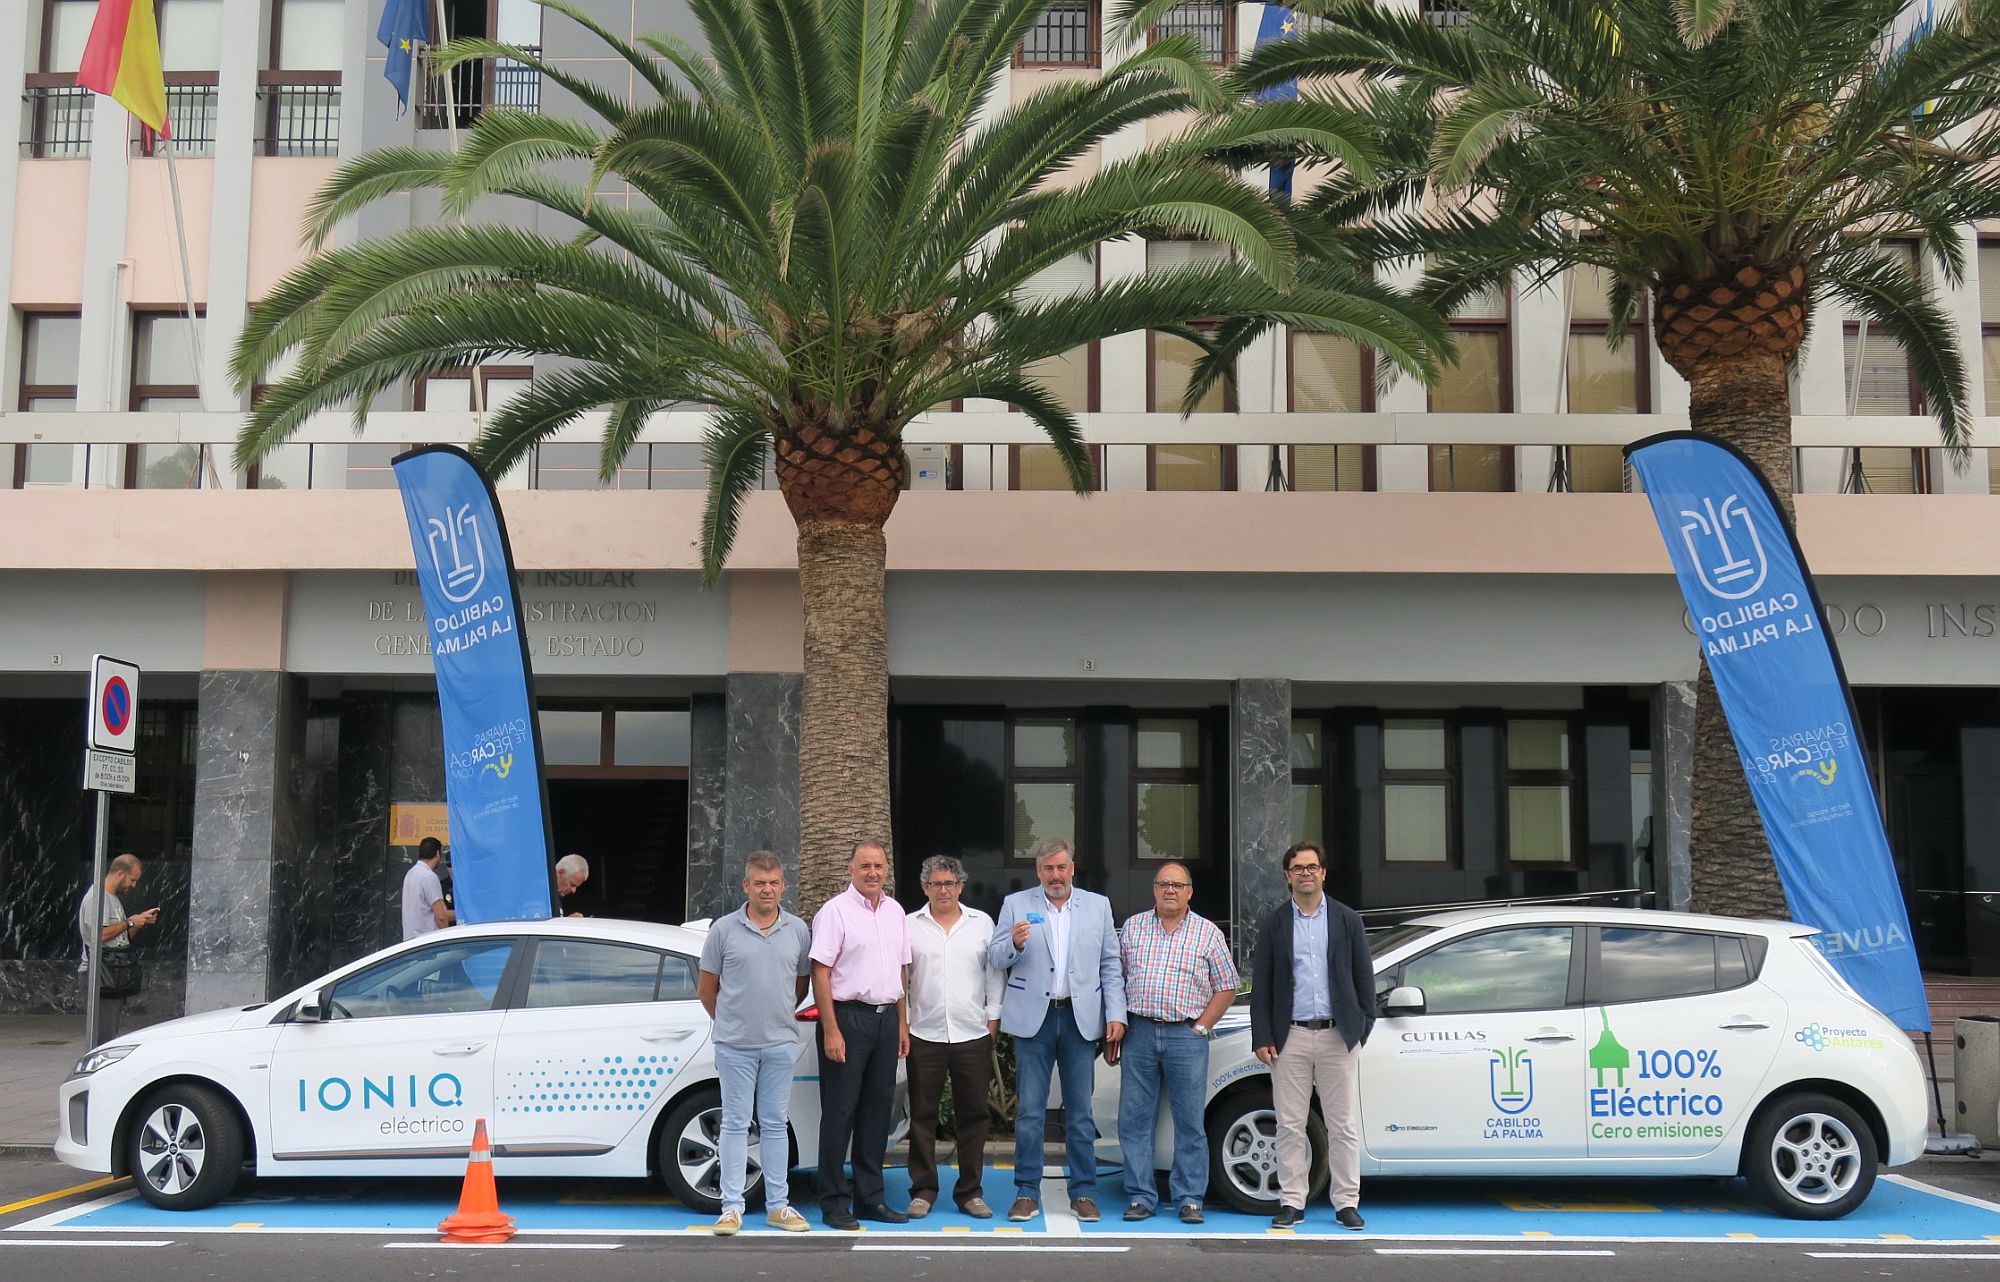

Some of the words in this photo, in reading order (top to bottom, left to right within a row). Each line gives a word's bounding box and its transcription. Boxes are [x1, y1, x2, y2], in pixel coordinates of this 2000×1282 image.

[537, 571, 636, 588] INSULAR
[368, 601, 394, 622] DE
[1926, 603, 1997, 638] INS
[546, 635, 644, 657] ESTADO
[1401, 1030, 1487, 1043] CUTILLAS
[1822, 1027, 1867, 1038] Proyecto
[1833, 1037, 1884, 1049] Antares
[1637, 1049, 1722, 1079] 100%
[1212, 1071, 1233, 1088] 100%
[299, 1072, 463, 1112] IONIQ
[1590, 1087, 1723, 1117] Eléctrico
[380, 1115, 464, 1135] eléctrico
[1486, 1118, 1541, 1129] CABILDO
[1591, 1122, 1633, 1139] Cero
[1636, 1121, 1724, 1138] emisiones
[1483, 1129, 1500, 1139] LA
[1502, 1129, 1544, 1139] PALMA
